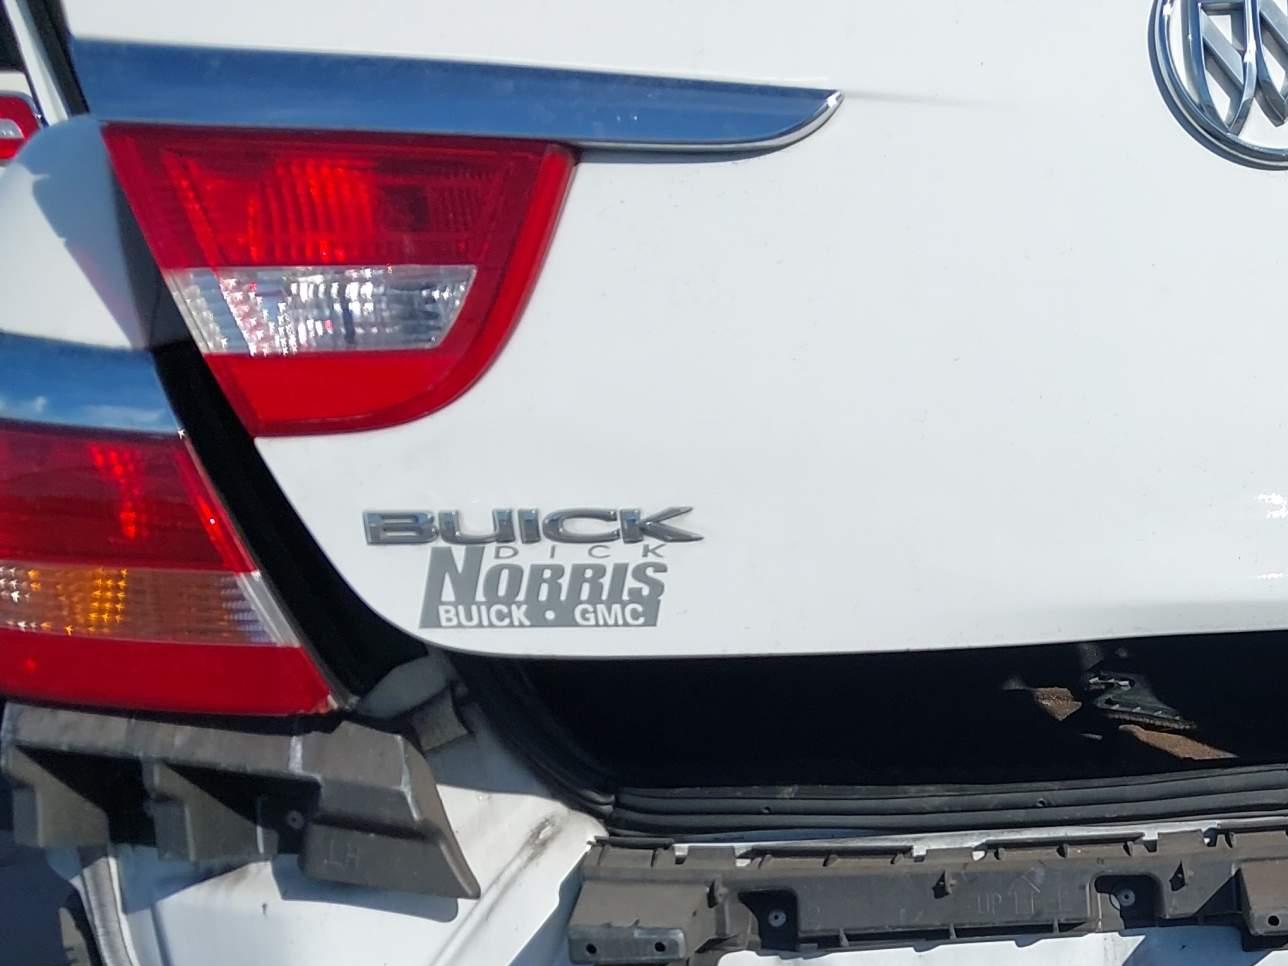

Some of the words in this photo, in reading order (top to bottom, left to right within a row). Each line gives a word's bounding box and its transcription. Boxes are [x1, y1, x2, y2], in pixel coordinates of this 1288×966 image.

[362, 506, 704, 546] BUICK
[493, 544, 667, 560] DICK
[423, 545, 669, 601] NORRIS
[437, 603, 531, 627] BUICK
[573, 602, 646, 626] GMC
